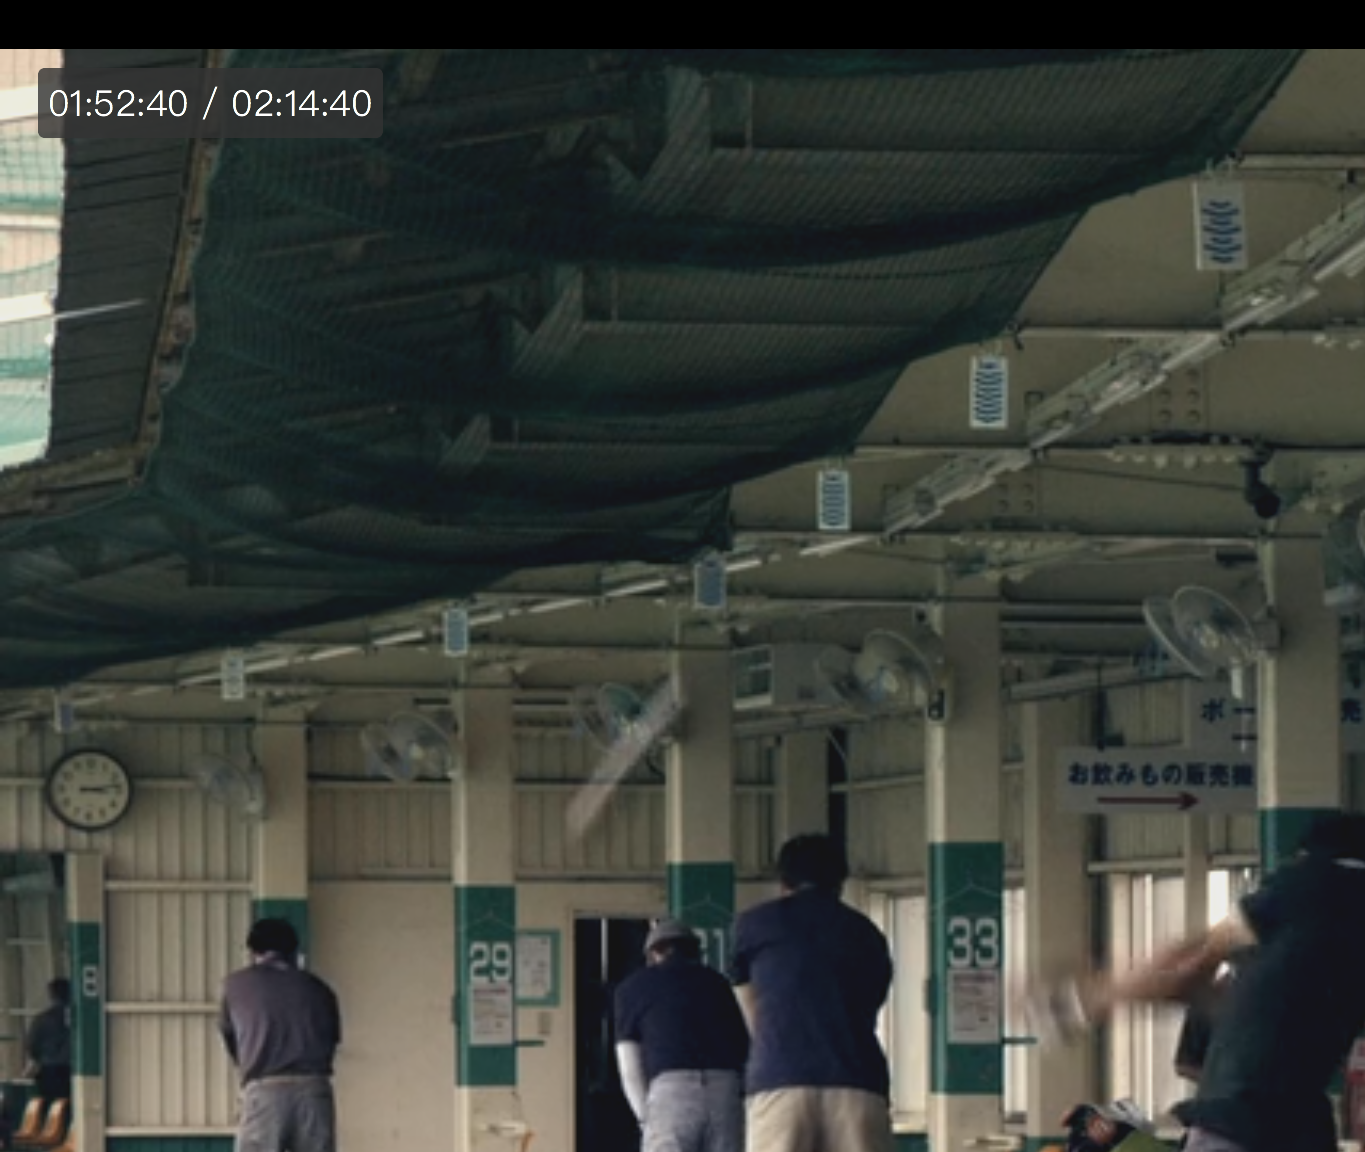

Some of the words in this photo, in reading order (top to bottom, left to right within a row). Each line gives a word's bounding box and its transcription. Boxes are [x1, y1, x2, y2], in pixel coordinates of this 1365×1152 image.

[1068, 762, 1254, 786] お飲みもの販売機
[469, 942, 512, 984] 29
[947, 917, 1000, 968] 33
